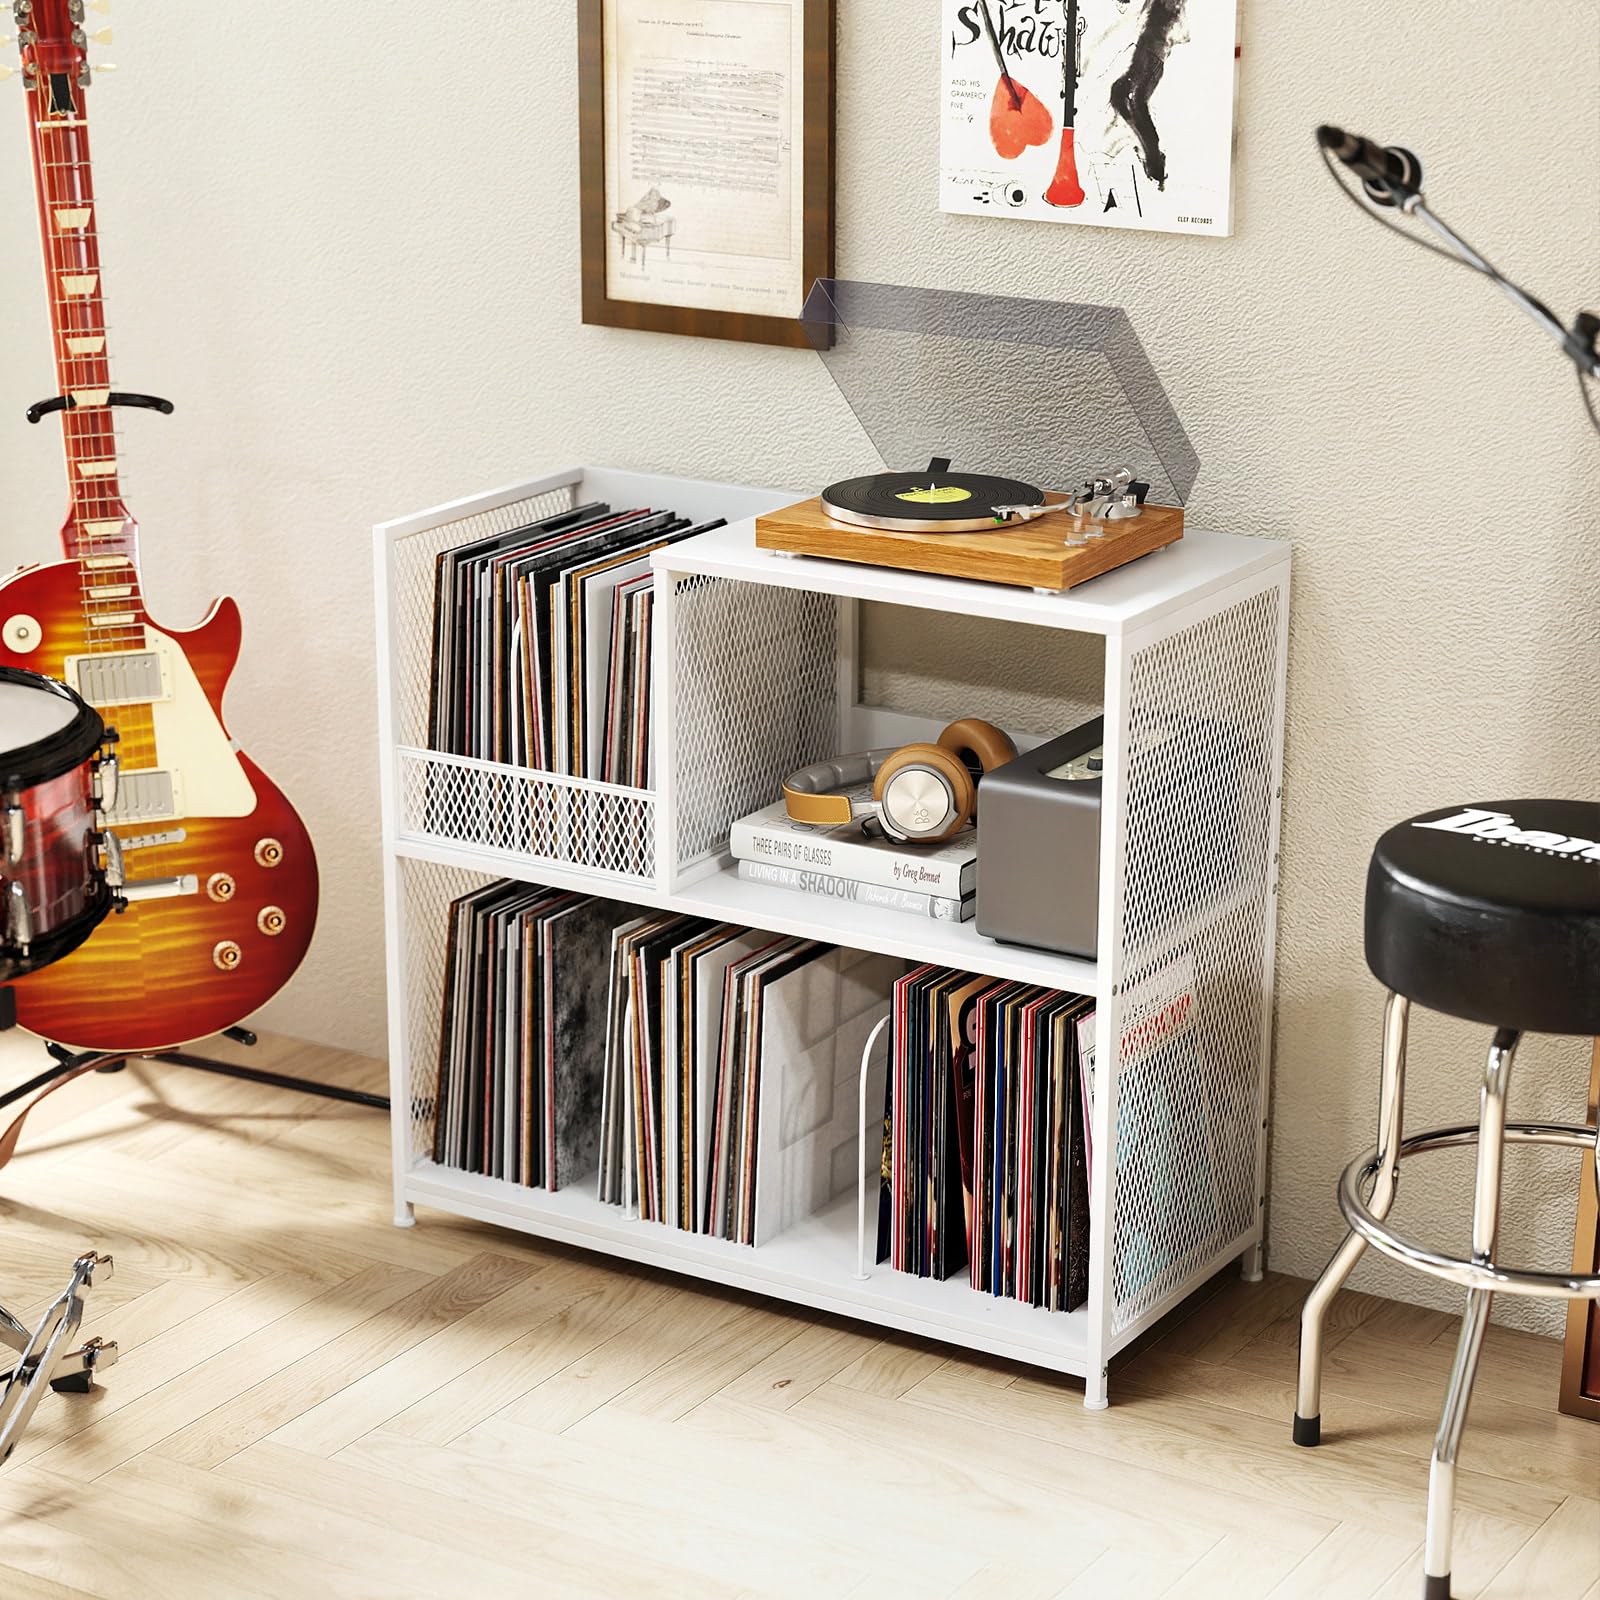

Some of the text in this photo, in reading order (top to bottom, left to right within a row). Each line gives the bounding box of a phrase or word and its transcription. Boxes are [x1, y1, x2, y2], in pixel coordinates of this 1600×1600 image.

[952, 0, 1061, 60] Shaw
[951, 79, 981, 88] AND HIS
[950, 90, 987, 100] GRAMERCY
[950, 101, 964, 110] FIVE
[1190, 217, 1213, 225] RECORDS
[752, 836, 833, 867] THREE PAIRS OF GLASSES
[893, 862, 942, 884] by Greg Bennet
[748, 862, 860, 901] LIVING IN A SHADOW
